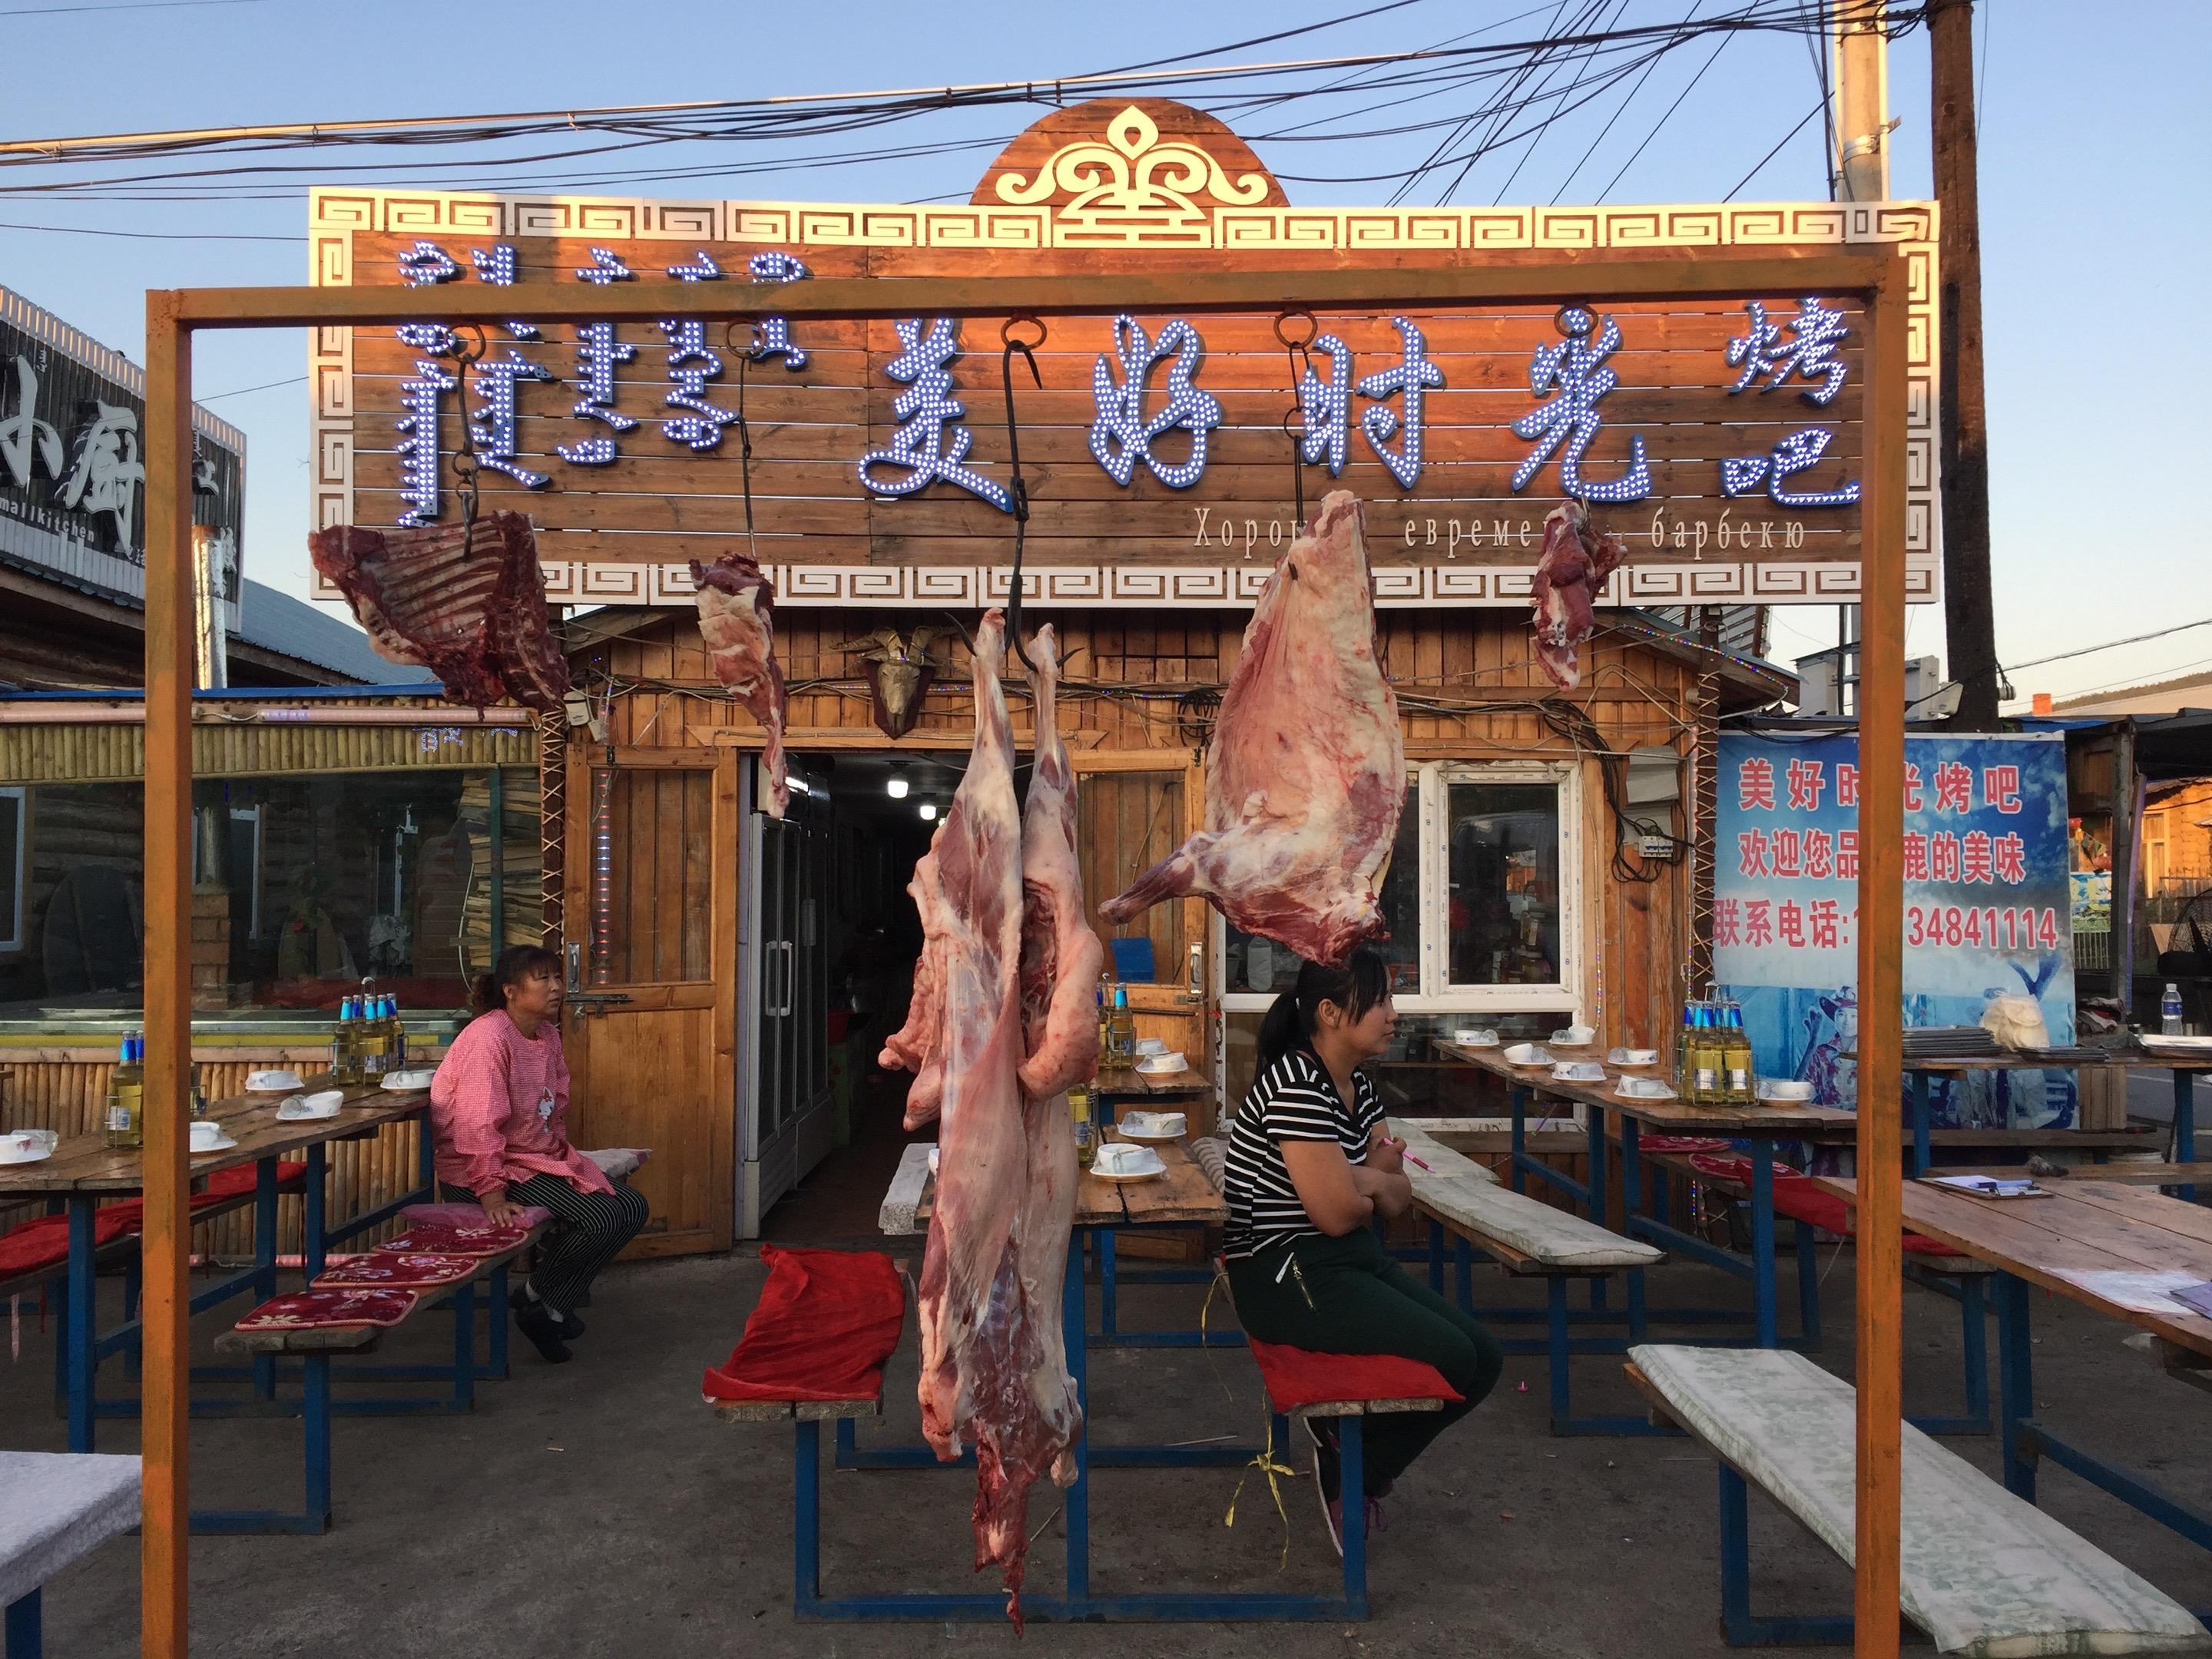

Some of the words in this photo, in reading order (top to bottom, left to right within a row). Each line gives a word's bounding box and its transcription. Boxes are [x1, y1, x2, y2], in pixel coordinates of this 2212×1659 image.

[1405, 518, 1548, 558] евреме
[1651, 506, 1804, 561] барбекю
[1738, 828, 2025, 883] 欢迎您品鹿的美味
